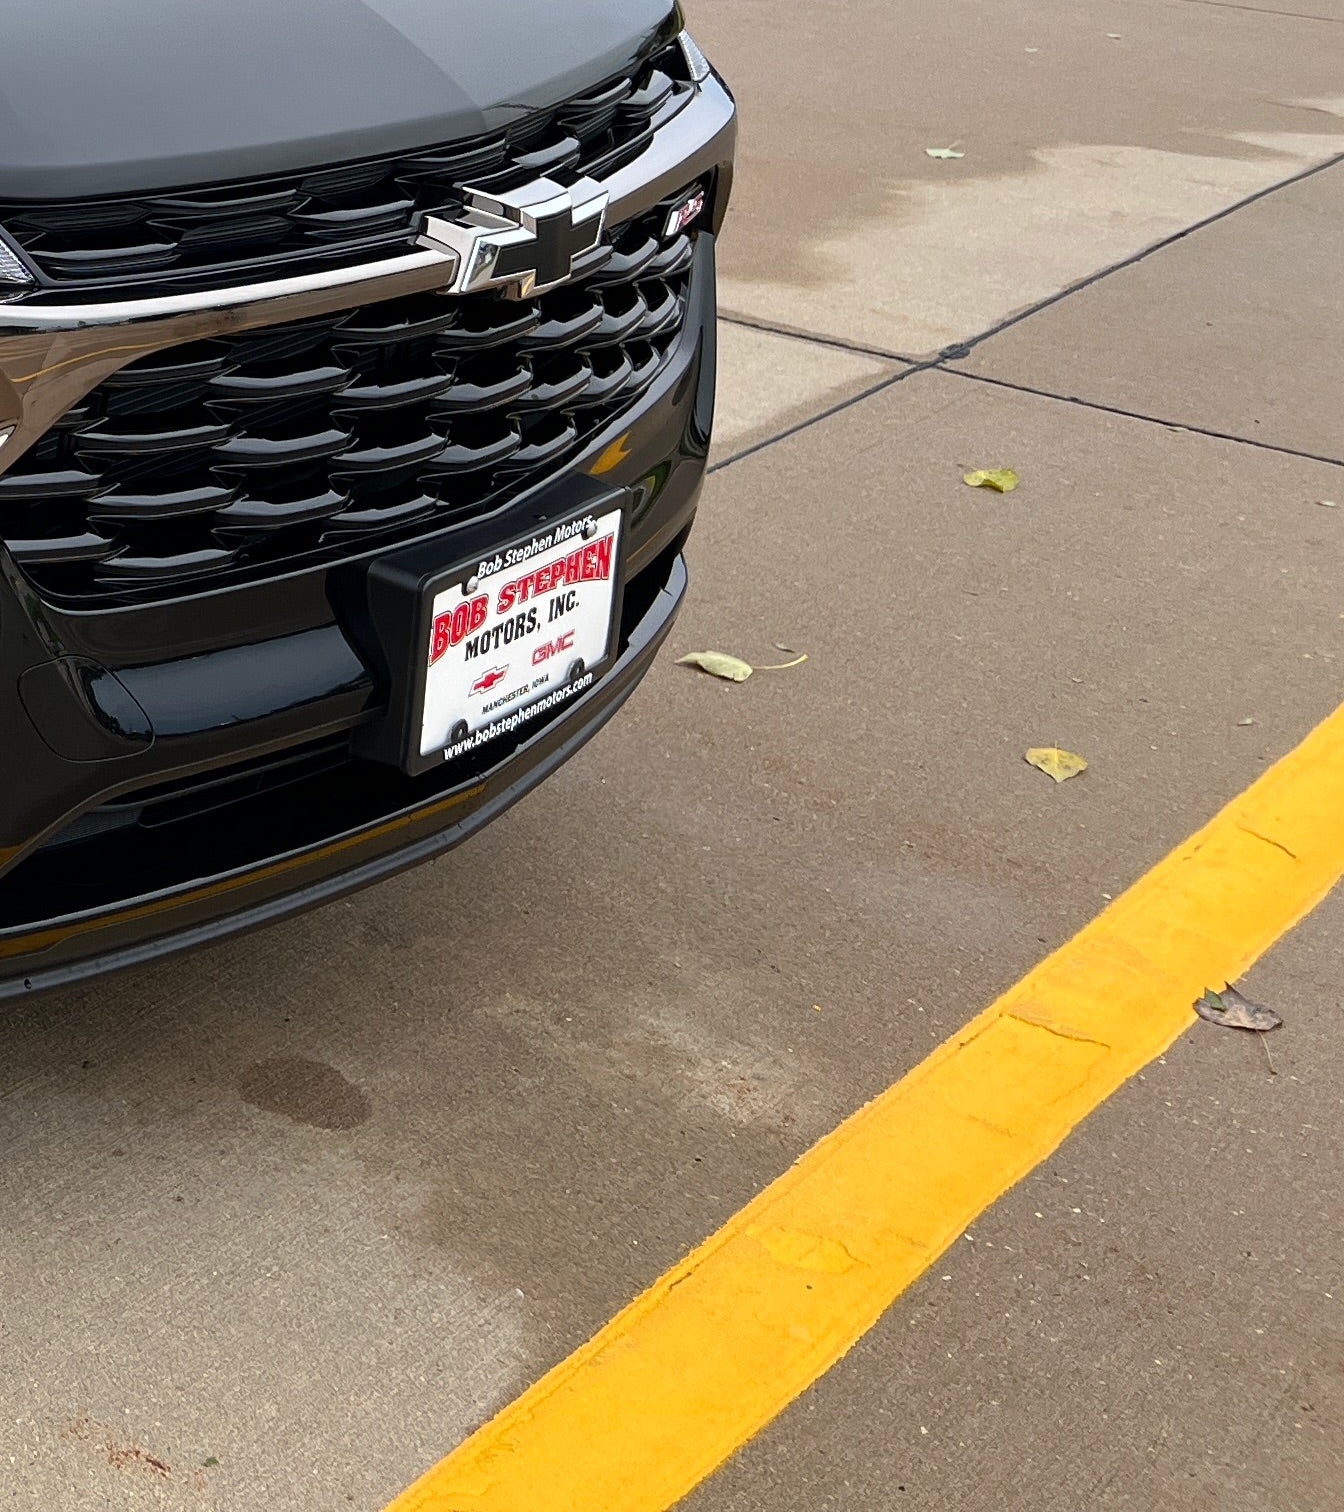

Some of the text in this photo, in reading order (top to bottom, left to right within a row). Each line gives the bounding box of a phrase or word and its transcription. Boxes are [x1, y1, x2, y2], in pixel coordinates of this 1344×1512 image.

[477, 514, 594, 580] Bob Stephen Motors
[429, 534, 614, 667] BOB STEPHEN
[464, 589, 579, 662] MOTORS, INC.
[531, 628, 575, 667] GMC
[443, 671, 593, 761] www.bobstephenmotors.com
